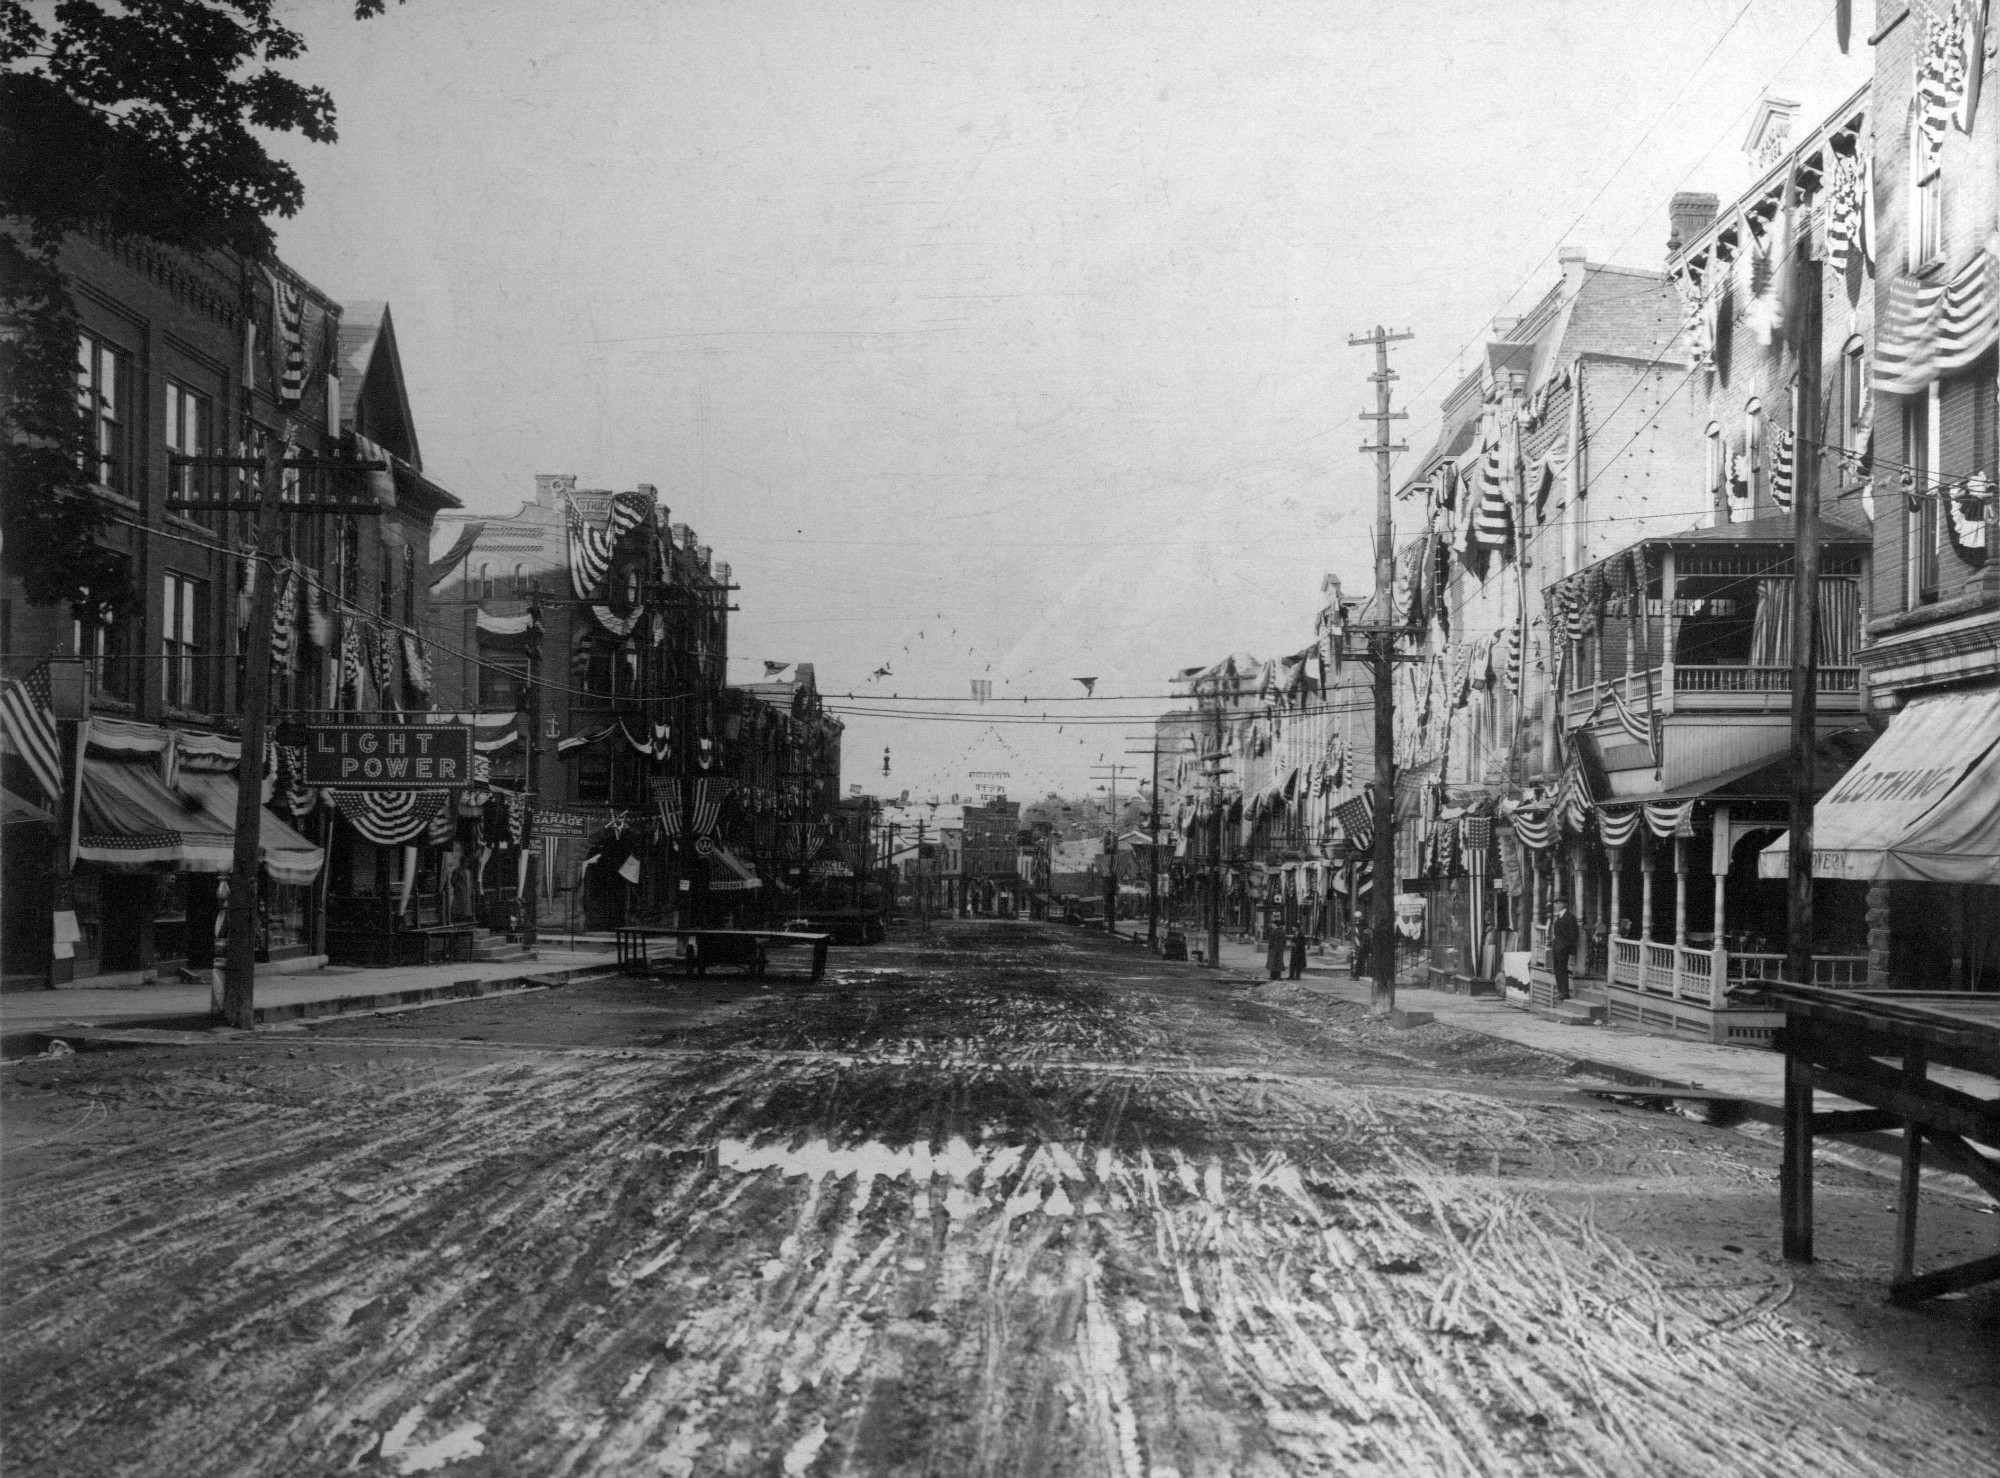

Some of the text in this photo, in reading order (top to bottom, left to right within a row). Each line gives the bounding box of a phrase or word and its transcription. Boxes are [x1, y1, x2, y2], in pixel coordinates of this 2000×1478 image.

[318, 733, 433, 754] LIGHT
[341, 757, 456, 778] POWER
[1829, 762, 1956, 804] CLOTHING
[532, 815, 584, 826] GARAGE
